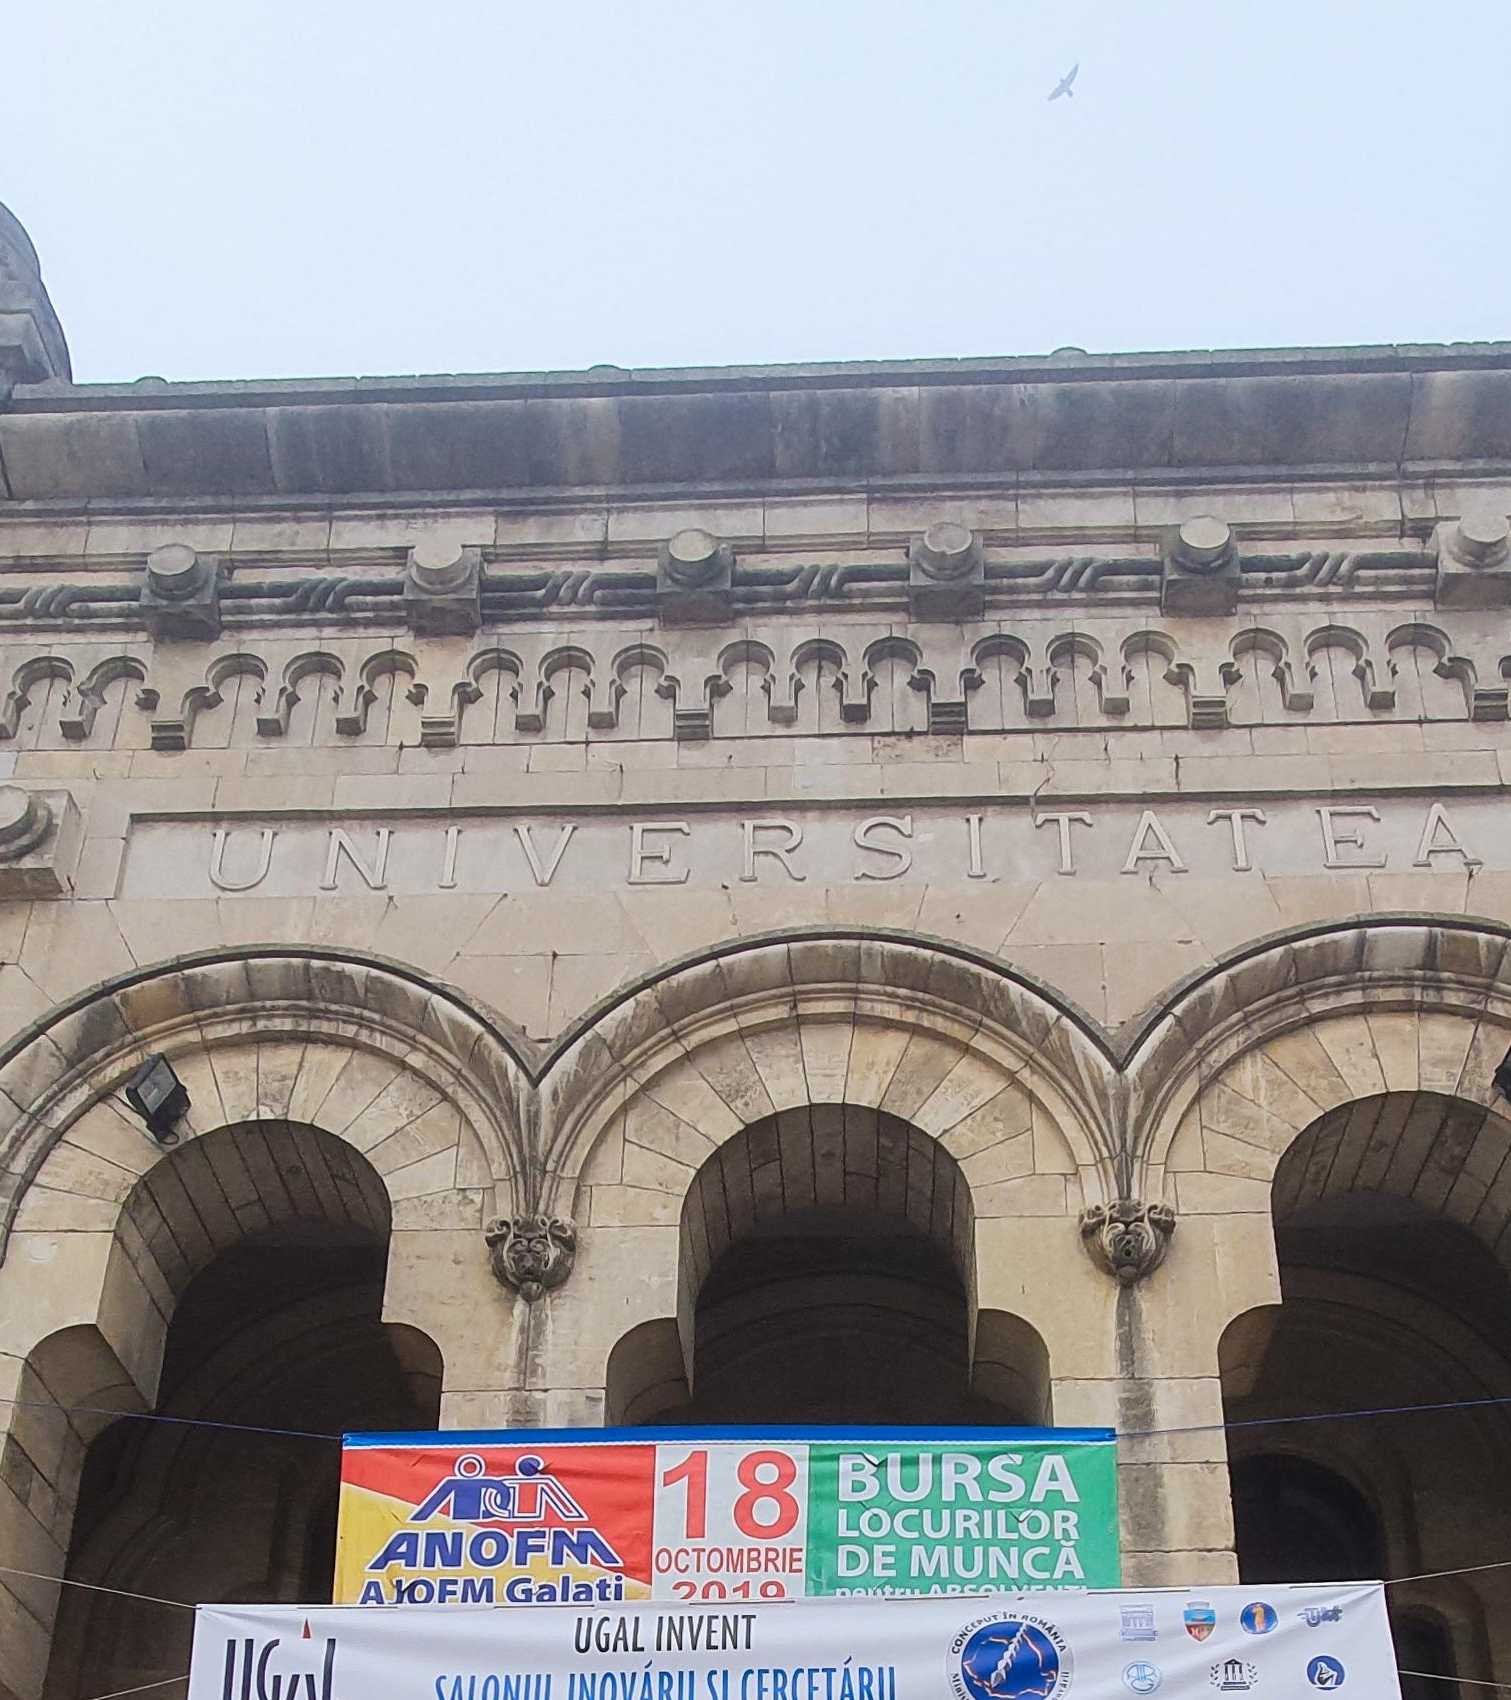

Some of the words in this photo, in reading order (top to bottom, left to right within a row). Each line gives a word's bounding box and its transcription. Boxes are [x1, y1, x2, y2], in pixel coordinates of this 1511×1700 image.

[209, 803, 1483, 891] UNIVERSITATEA
[662, 1450, 800, 1540] 18
[838, 1453, 1080, 1502] BURSA
[837, 1508, 1080, 1540] LOCURILOR
[368, 1529, 621, 1570] ANOFM
[655, 1547, 804, 1574] OCTOMBRIE
[837, 1545, 896, 1577] DE
[910, 1540, 1085, 1579] MUNCĂ
[574, 1616, 645, 1653] UGAL
[656, 1614, 756, 1651] INVENT
[951, 1614, 999, 1655] CONCEPUT
